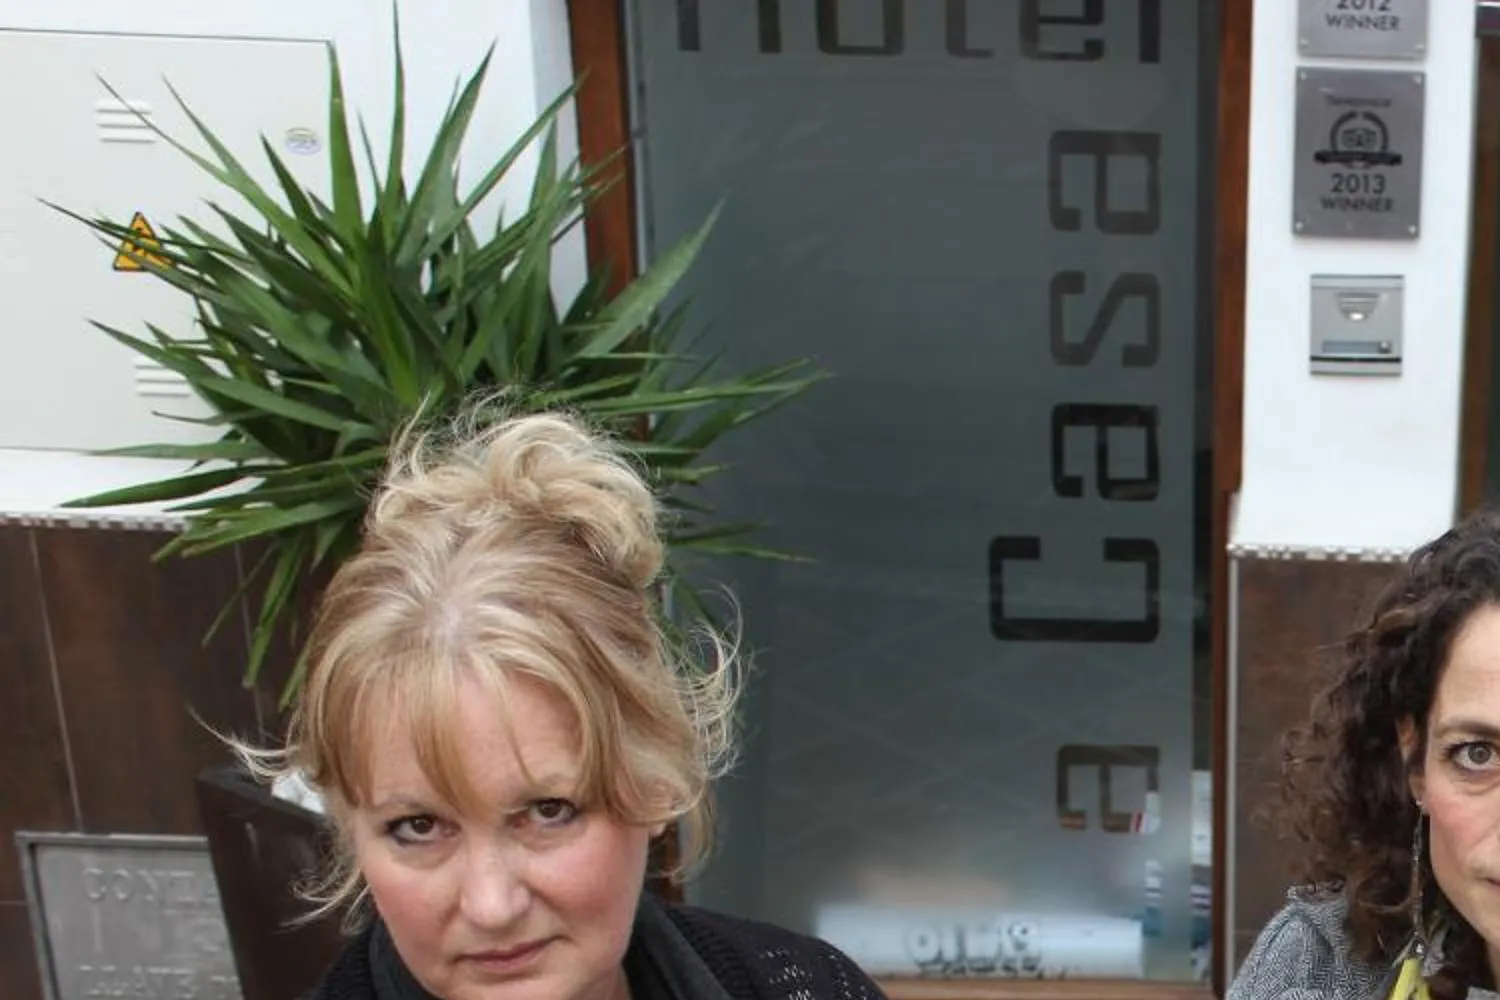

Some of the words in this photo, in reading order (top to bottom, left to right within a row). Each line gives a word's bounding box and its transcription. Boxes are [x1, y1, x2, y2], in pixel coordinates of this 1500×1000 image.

[1325, 14, 1400, 31] WINNER
[1331, 172, 1386, 195] 2013
[1320, 196, 1394, 213] WINNER
[988, 130, 1161, 643] Casa
